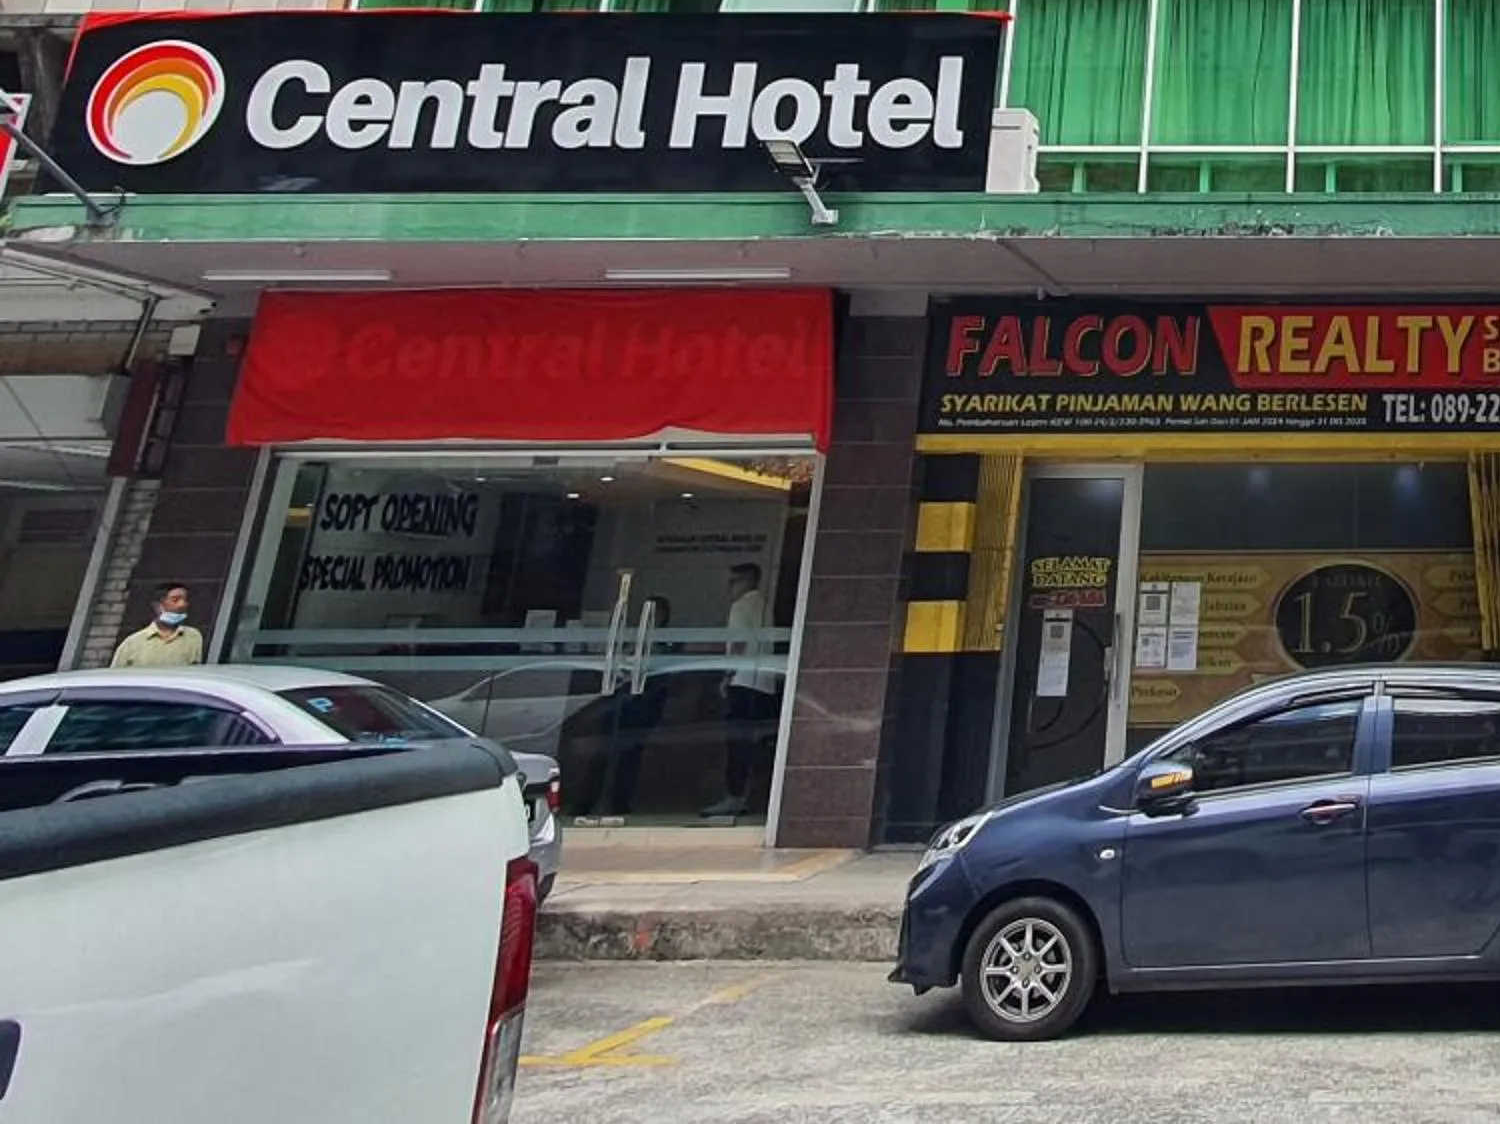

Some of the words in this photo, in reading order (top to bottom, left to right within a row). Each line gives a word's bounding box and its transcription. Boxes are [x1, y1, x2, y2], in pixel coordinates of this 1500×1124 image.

[245, 56, 651, 150] Central
[668, 56, 964, 149] Hotel
[946, 315, 1201, 377] FALCON
[1238, 315, 1476, 374] REALTY
[939, 393, 1051, 413] SYARIKAT
[1055, 393, 1173, 413] PINJAMAN
[1179, 393, 1250, 412] WANG
[1257, 393, 1368, 413] BERLESEN
[1382, 394, 1426, 423] TEL:
[379, 493, 479, 537] OPENING
[297, 554, 367, 592] SPECIAL
[370, 554, 471, 593] PROMOTION
[1031, 556, 1112, 573] SELAMAT
[1033, 572, 1108, 588] DATANG
